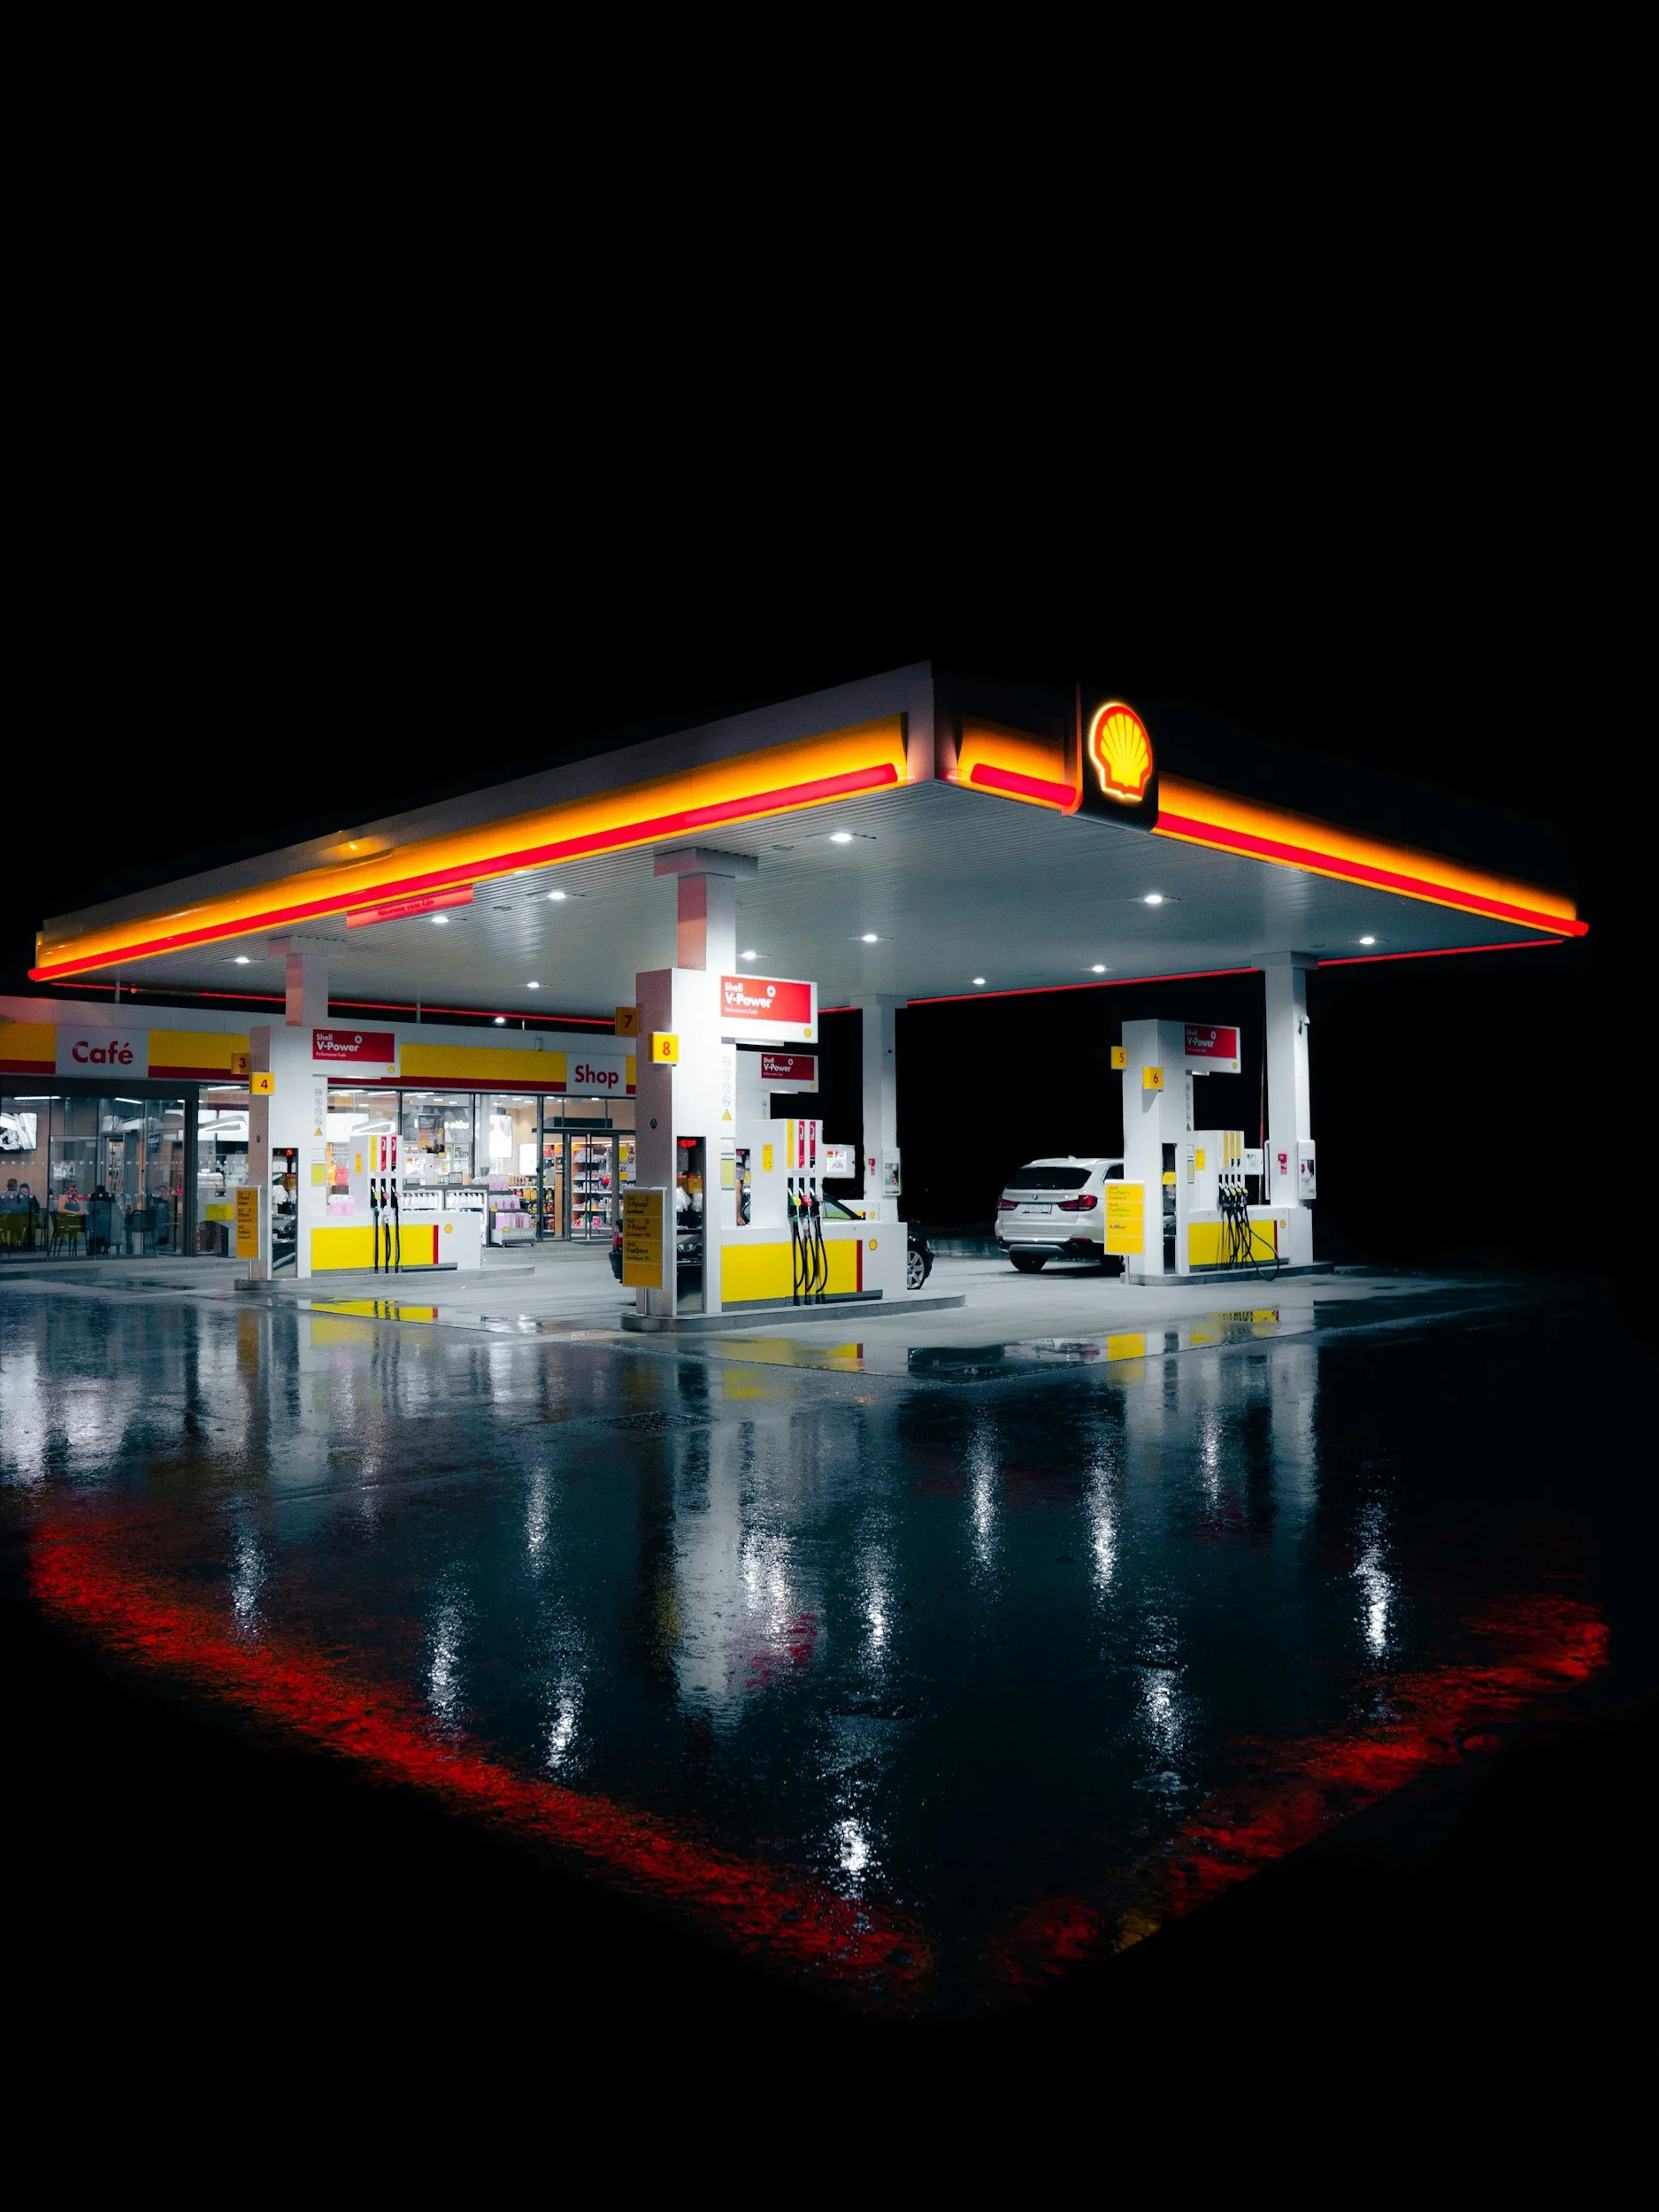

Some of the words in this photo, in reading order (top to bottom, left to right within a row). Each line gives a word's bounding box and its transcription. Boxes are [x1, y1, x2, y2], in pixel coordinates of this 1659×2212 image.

[724, 981, 743, 992] Shell
[724, 991, 772, 1009] V-Power
[623, 1014, 634, 1029] 7
[316, 1041, 359, 1052] V-Power
[1187, 1036, 1214, 1048] V-Power
[71, 1041, 134, 1065] Café
[663, 1041, 671, 1056] 8
[239, 1056, 247, 1069] 3
[1119, 1052, 1125, 1064] 5
[763, 1063, 792, 1072] V-Power
[574, 1064, 619, 1089] Shop
[1153, 1072, 1159, 1084] 6
[260, 1079, 269, 1089] 4
